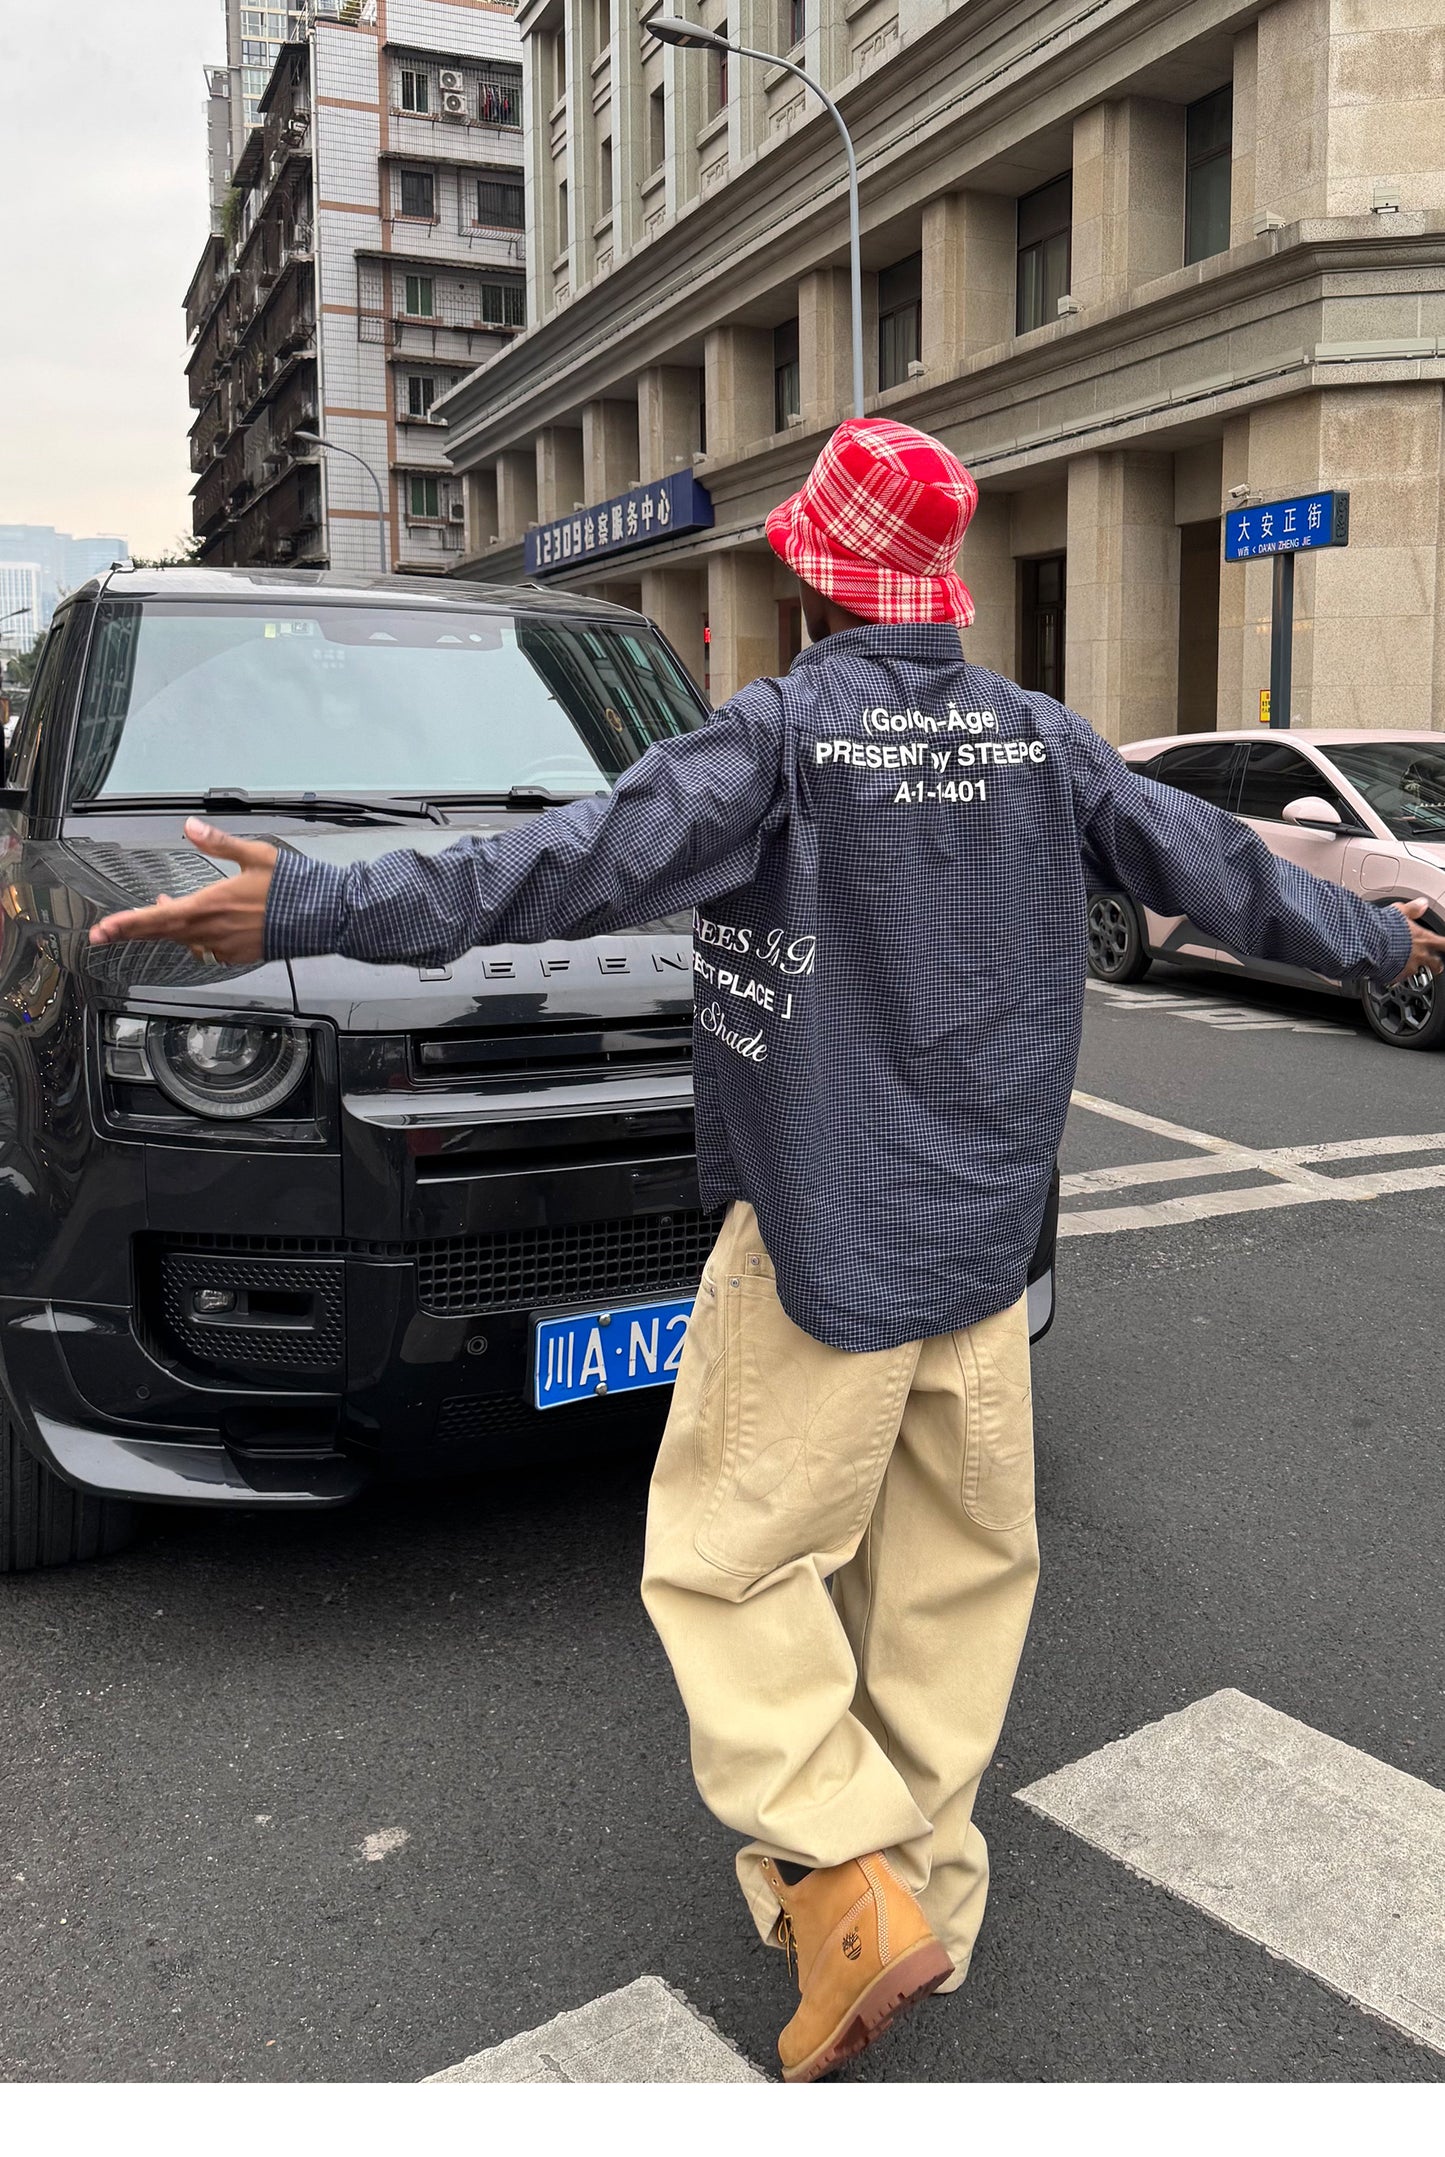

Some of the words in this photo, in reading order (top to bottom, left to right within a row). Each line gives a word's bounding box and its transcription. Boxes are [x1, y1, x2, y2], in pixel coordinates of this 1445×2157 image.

[535, 488, 671, 566] 12309检察服务中心
[1237, 502, 1322, 542] 大安正街
[1278, 537, 1299, 550] ZHENG
[1302, 535, 1312, 547] JIE
[816, 740, 929, 768] PRESENT
[718, 969, 775, 1012] PLACE
[700, 1001, 769, 1062] Shade
